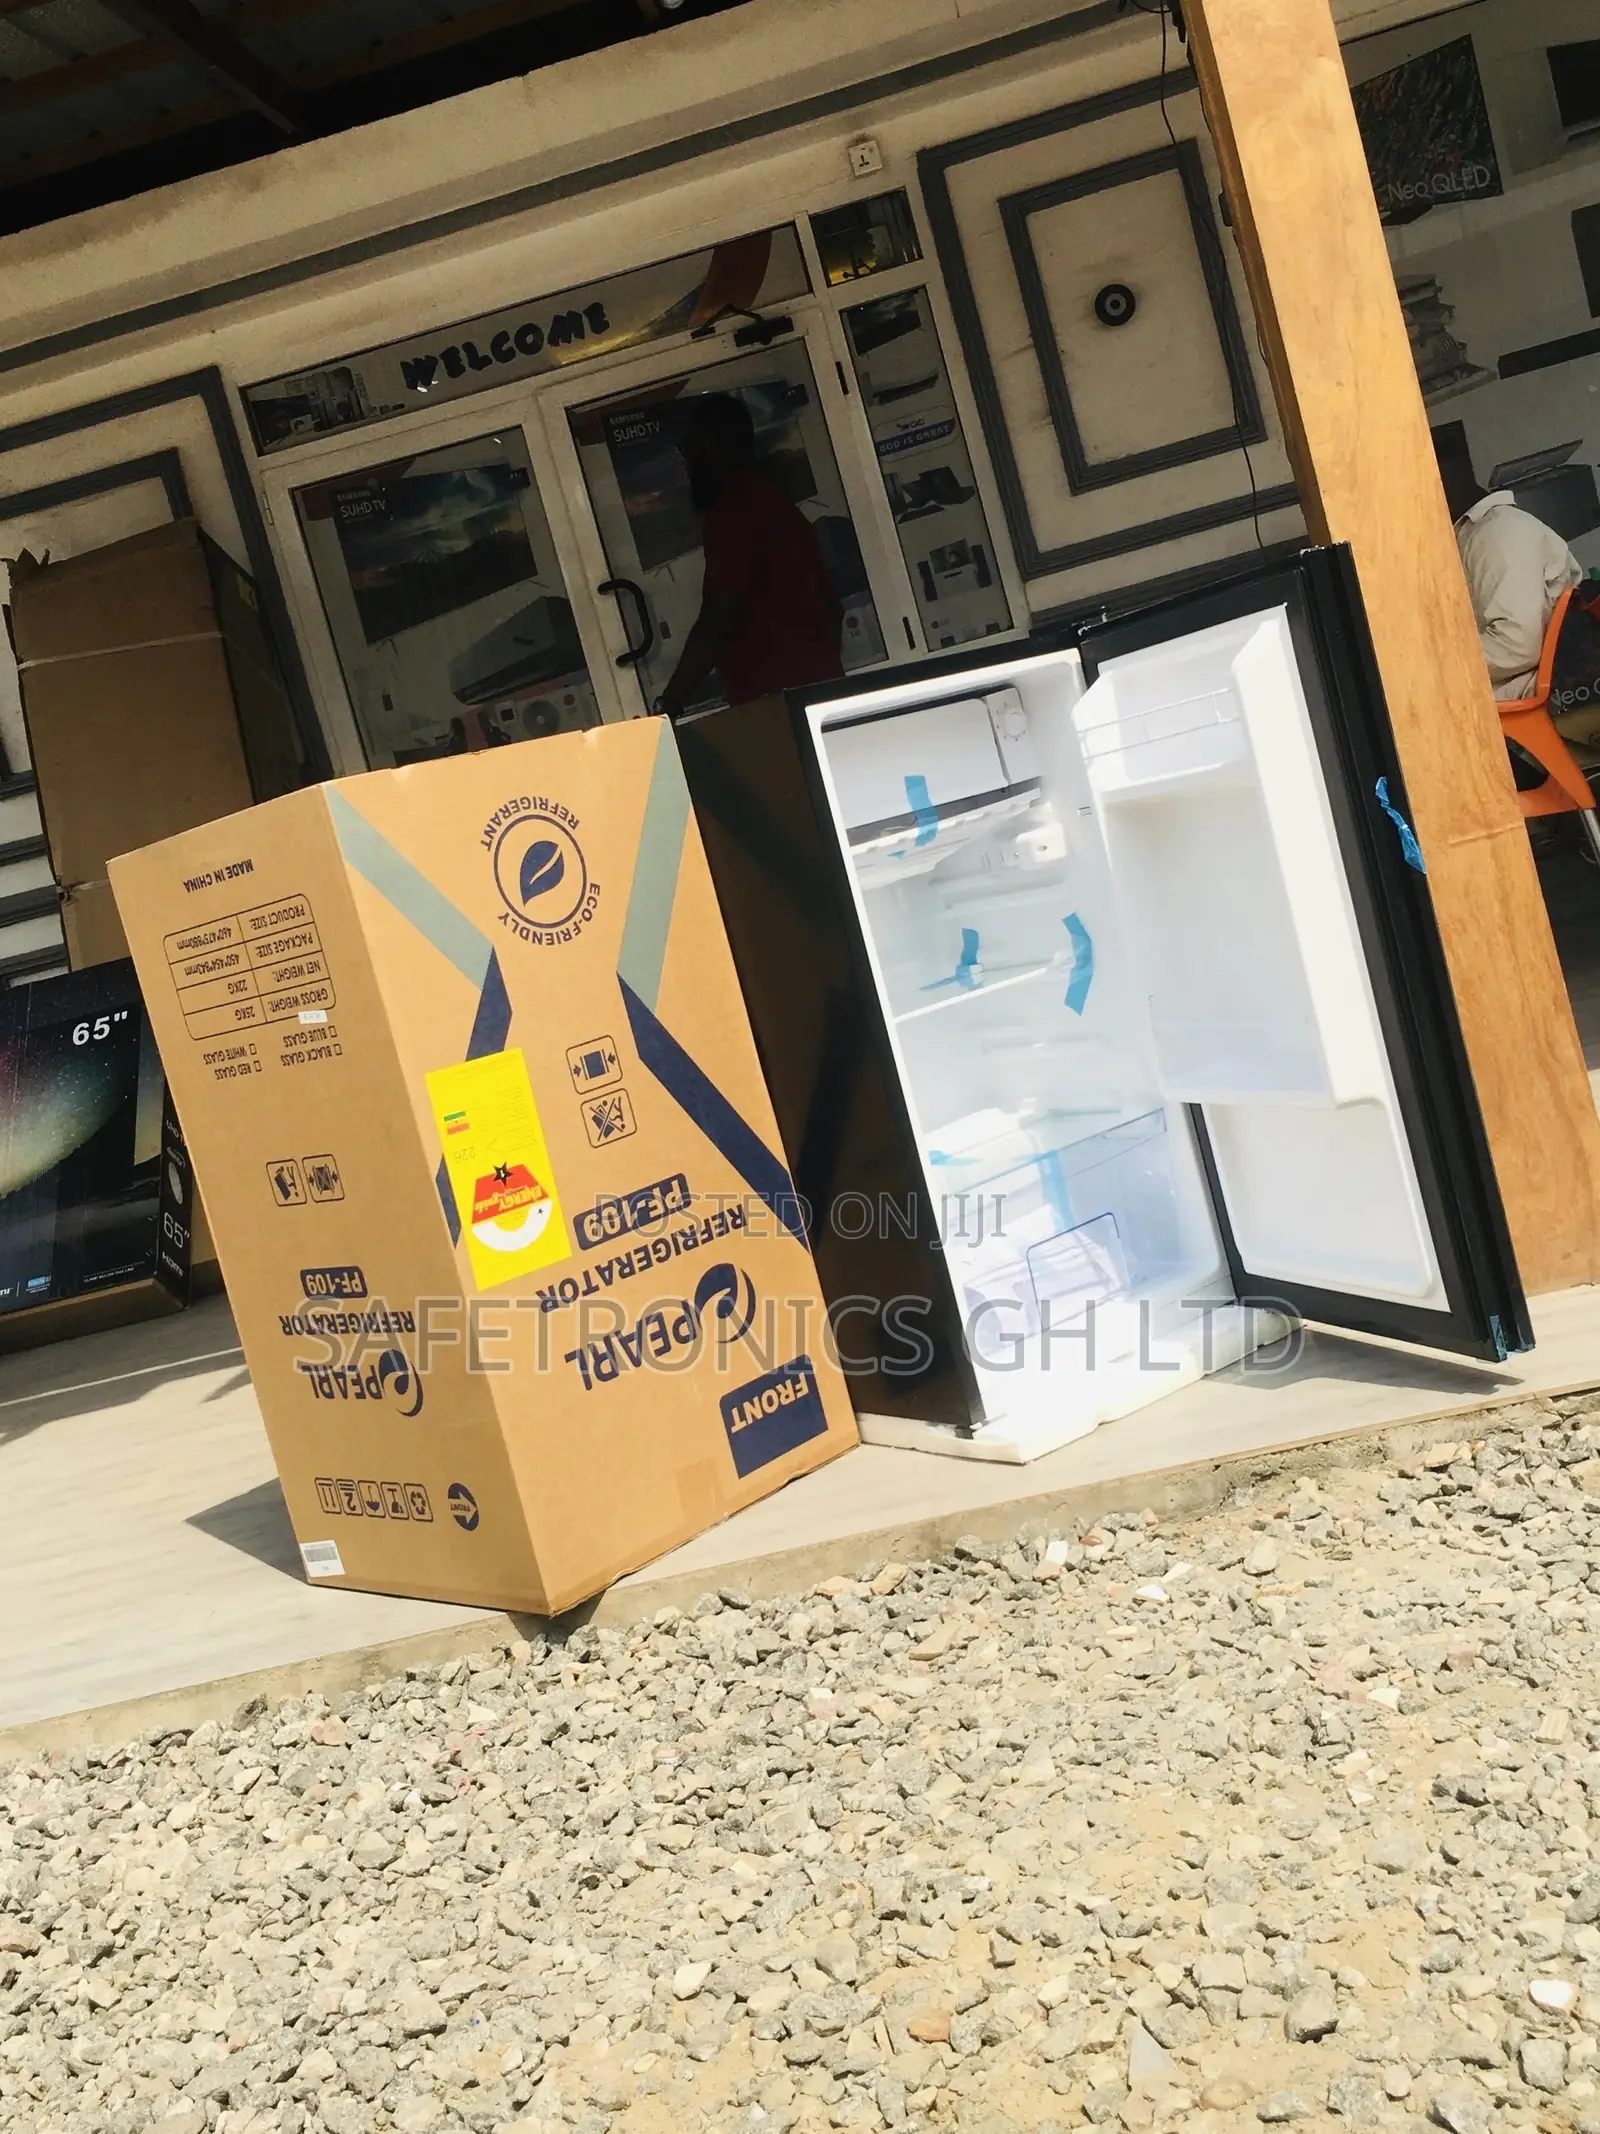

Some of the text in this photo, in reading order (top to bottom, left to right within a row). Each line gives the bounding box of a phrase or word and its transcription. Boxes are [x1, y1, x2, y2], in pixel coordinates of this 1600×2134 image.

[1387, 164, 1491, 201] Neo QLED
[400, 301, 610, 391] WELCOME
[613, 420, 661, 443] SUHD TV
[916, 423, 949, 443] GREAT
[340, 499, 387, 518] SUHD TV
[480, 796, 581, 852] REFRIGERANT
[182, 858, 254, 894] MADE IN CHINA
[249, 904, 306, 931] PRODUCT SIZE:
[497, 882, 601, 946] ECO-FRIENDLY
[255, 932, 314, 959] PACKAGE SIZE:
[273, 960, 321, 983] NET WEIGHT:
[227, 979, 248, 995] 22KG
[267, 988, 329, 1013] GROSS WEIGHT:
[234, 1005, 256, 1021] 25KG
[72, 1010, 129, 1046] 65"
[283, 1028, 328, 1048] BLUE GLASS
[203, 1045, 247, 1065] WHITE GLASS
[280, 1046, 333, 1067] BLACK GLASS
[215, 1061, 252, 1081] RED GLASS
[455, 1145, 478, 1164] 226
[498, 1183, 543, 1212] ENERGY
[583, 1178, 685, 1243] PF-109
[163, 1211, 191, 1249] 65"
[535, 1203, 748, 1314] REFRIGERATOR
[305, 1270, 364, 1295] PF-109
[277, 1309, 416, 1336] REFRIGERATOR
[563, 1300, 703, 1391] PEARL
[300, 1363, 385, 1400] PEARL
[730, 1371, 811, 1434] FRONT
